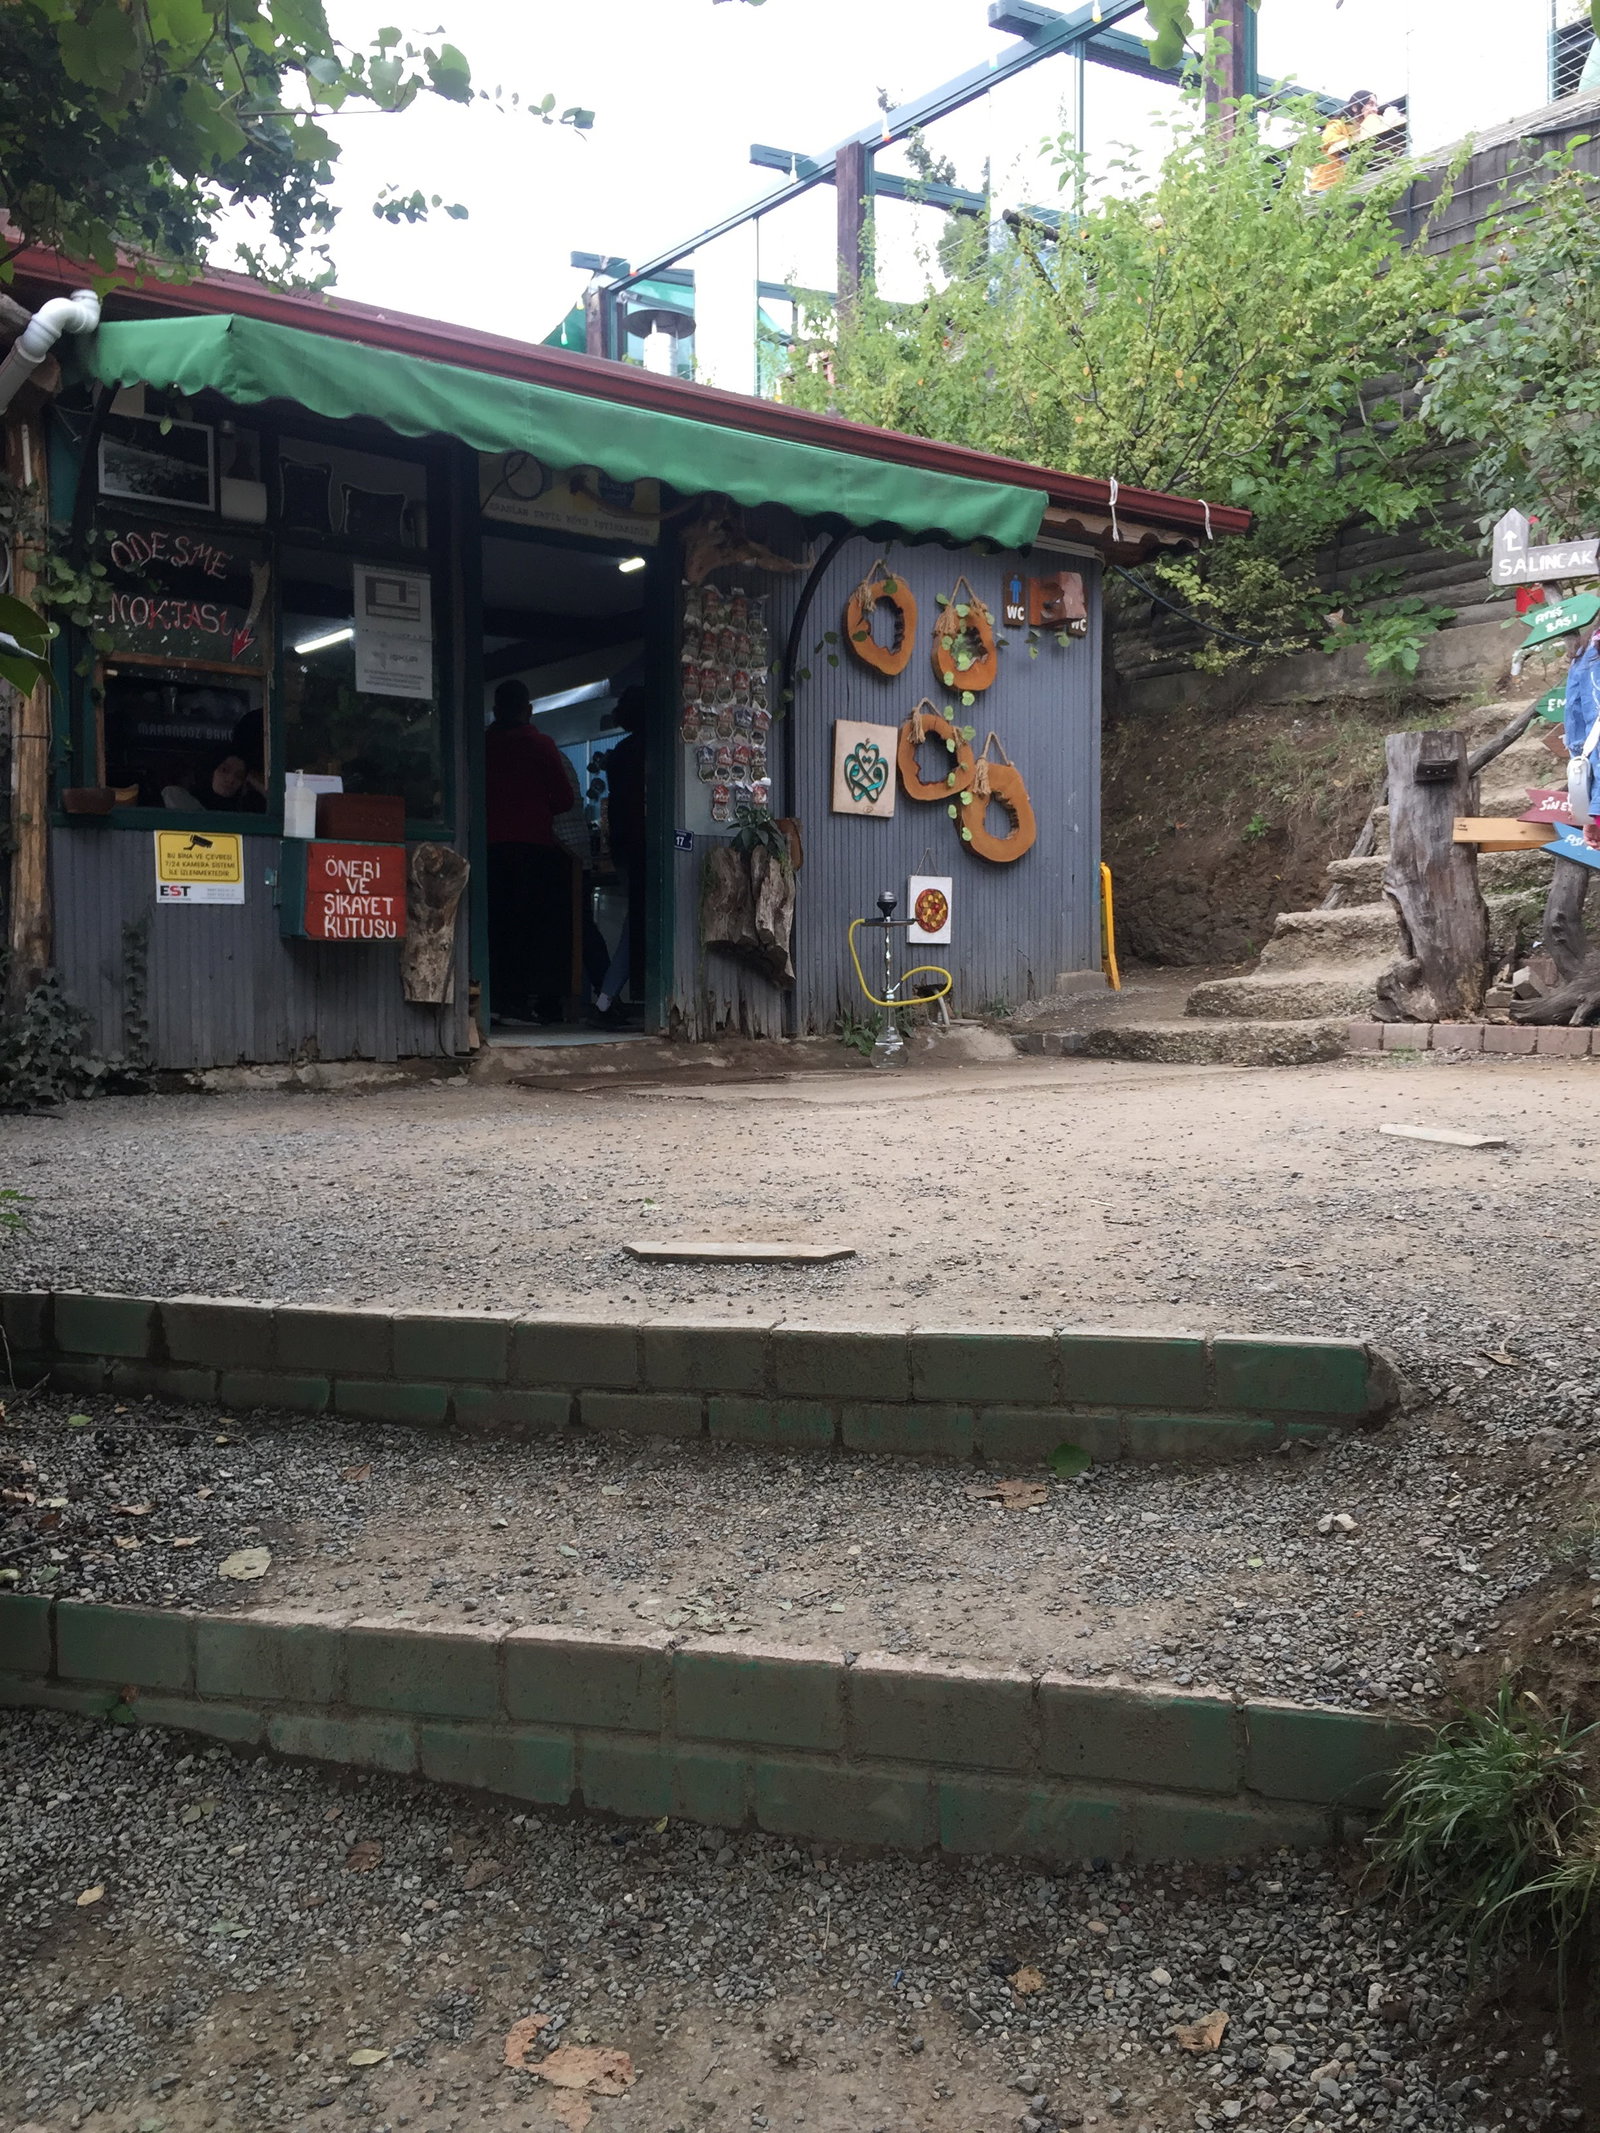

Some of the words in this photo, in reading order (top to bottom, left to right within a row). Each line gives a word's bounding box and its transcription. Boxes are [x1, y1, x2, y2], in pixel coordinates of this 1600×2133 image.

[1498, 551, 1594, 577] SALINCAK
[1006, 605, 1025, 620] WC
[676, 836, 685, 847] 17
[325, 855, 380, 879] ÖNERİ
[160, 885, 191, 897] EST
[346, 877, 371, 894] VE
[324, 915, 397, 938] KUTUSU
